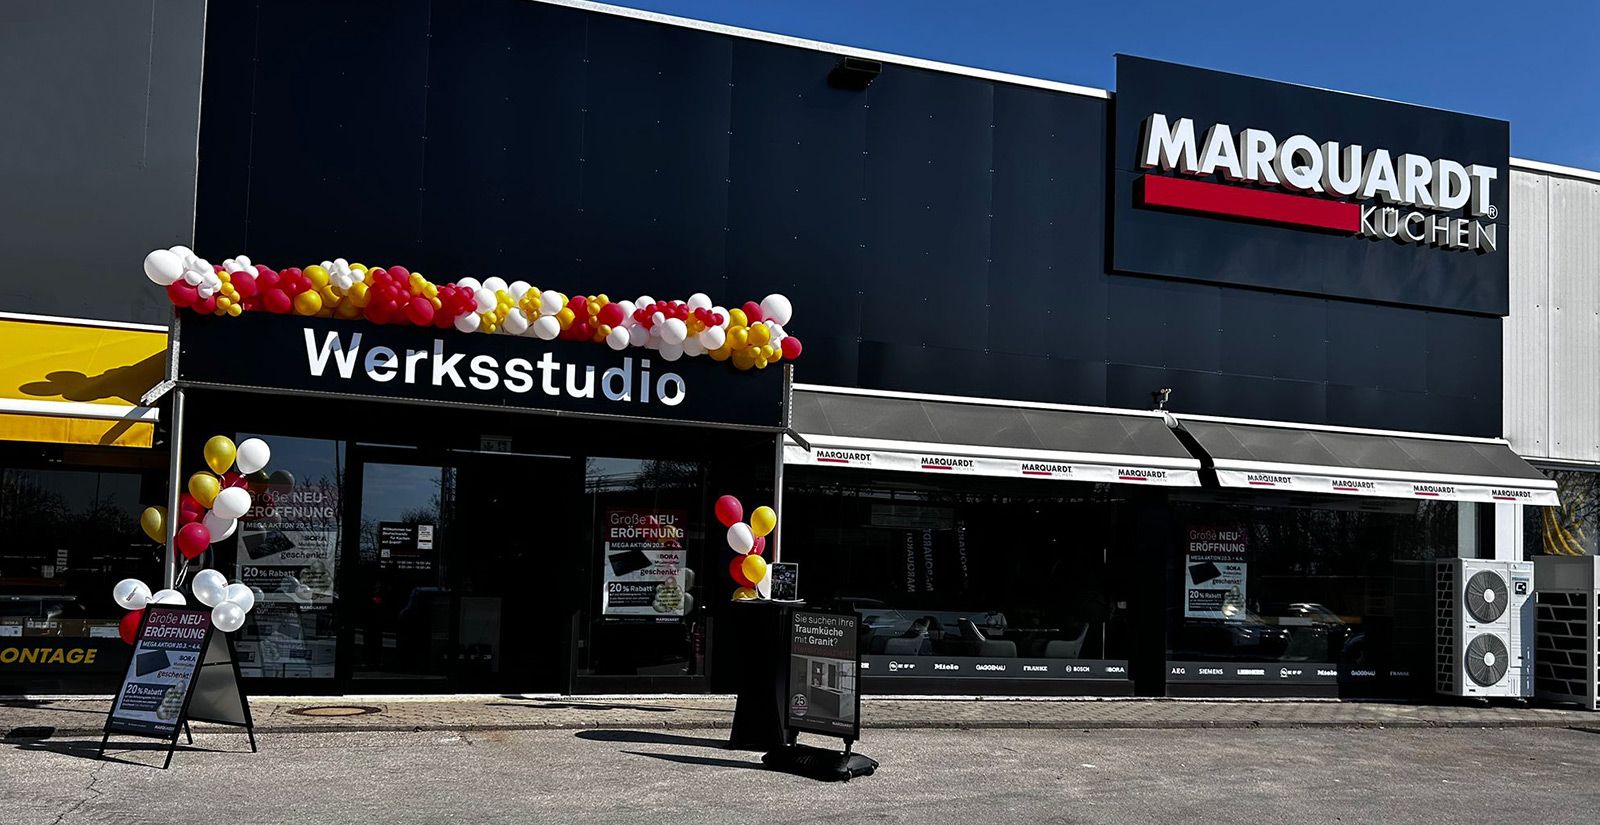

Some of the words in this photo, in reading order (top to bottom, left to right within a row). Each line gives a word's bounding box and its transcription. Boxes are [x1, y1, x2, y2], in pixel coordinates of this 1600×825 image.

[1142, 113, 1497, 216] MARQUARDT
[1361, 205, 1497, 252] KÜCHEN
[303, 328, 686, 406] Werksstudio
[816, 450, 871, 461] MARQUARDT
[921, 457, 975, 467] MARQUARDT
[1021, 463, 1072, 473] MARQUARDT
[1118, 469, 1167, 479] MARQUARDT
[1247, 474, 1292, 484] MARQUARDT
[1332, 480, 1376, 489] MARQUARDT
[1413, 485, 1455, 494] MARQUARDT
[248, 490, 289, 503] Große
[1491, 489, 1532, 498] MARQUARDT
[246, 503, 334, 518] ERÖFFNUNG
[610, 513, 647, 525] Große
[649, 515, 679, 525] NEU-
[610, 526, 684, 538] ERÖFFNUNG
[1218, 531, 1241, 541] NEU-
[1189, 540, 1246, 553] ERÖFFNUNG
[243, 567, 259, 577] 20
[609, 583, 622, 592] 20
[1189, 590, 1199, 599] 20
[148, 612, 178, 624] Große
[180, 614, 205, 625] NEU-
[794, 613, 807, 623] Sie
[808, 616, 837, 626] suchen
[838, 617, 854, 627] Ihre
[144, 624, 206, 639] ERÖFFNUNG
[794, 624, 844, 637] Traumküche
[794, 636, 807, 644] mit
[808, 635, 838, 647] Granit?
[126, 684, 138, 694] 20
[143, 687, 163, 696] Rabatt
[794, 695, 805, 706] 25
